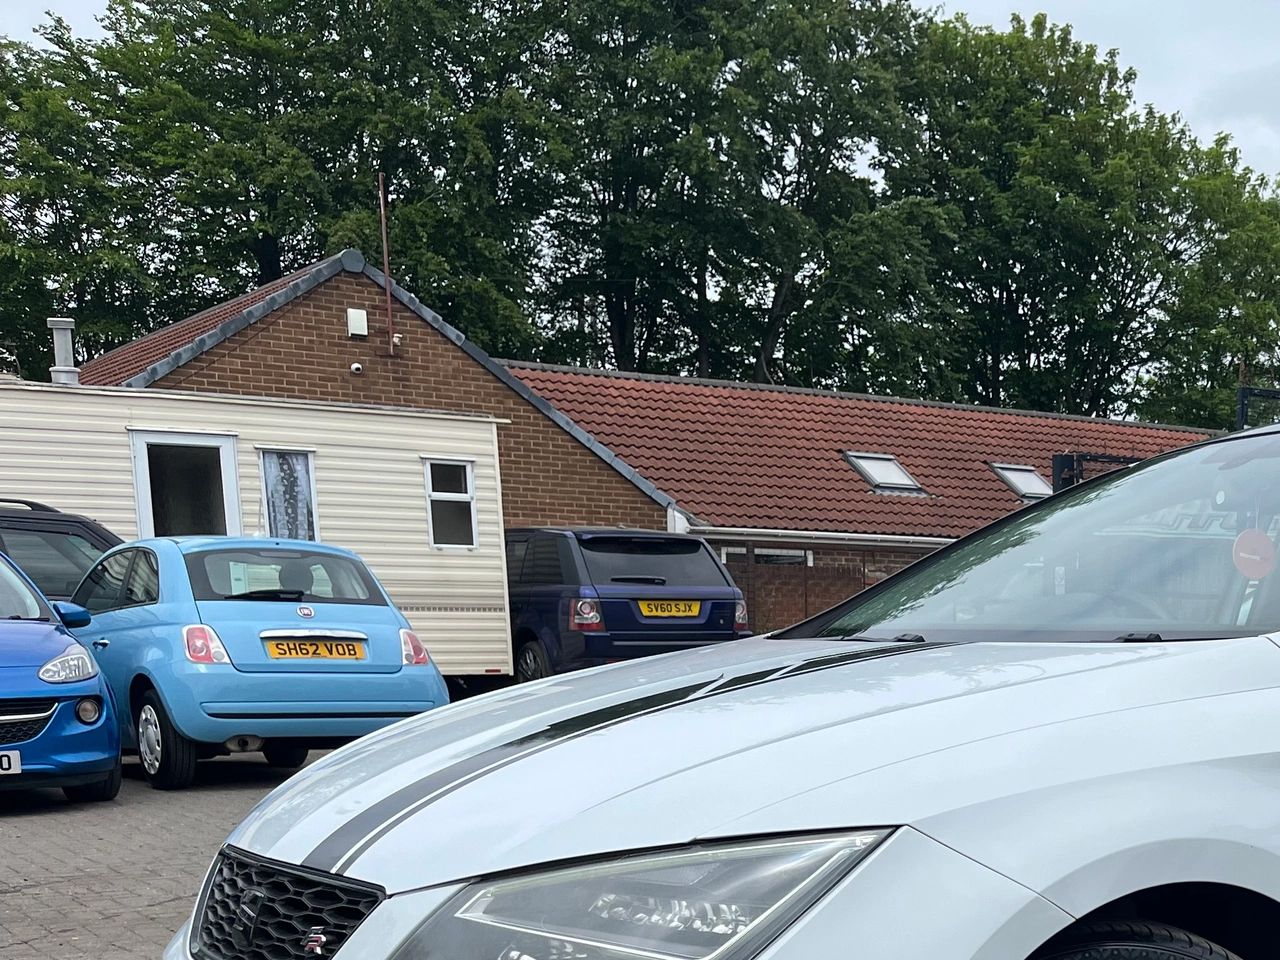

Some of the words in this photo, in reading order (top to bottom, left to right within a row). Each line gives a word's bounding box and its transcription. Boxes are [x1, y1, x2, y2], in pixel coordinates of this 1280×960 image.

[647, 603, 672, 613] SV60
[675, 603, 693, 613] SJX
[275, 642, 321, 656] SH62
[324, 643, 357, 656] VOB
